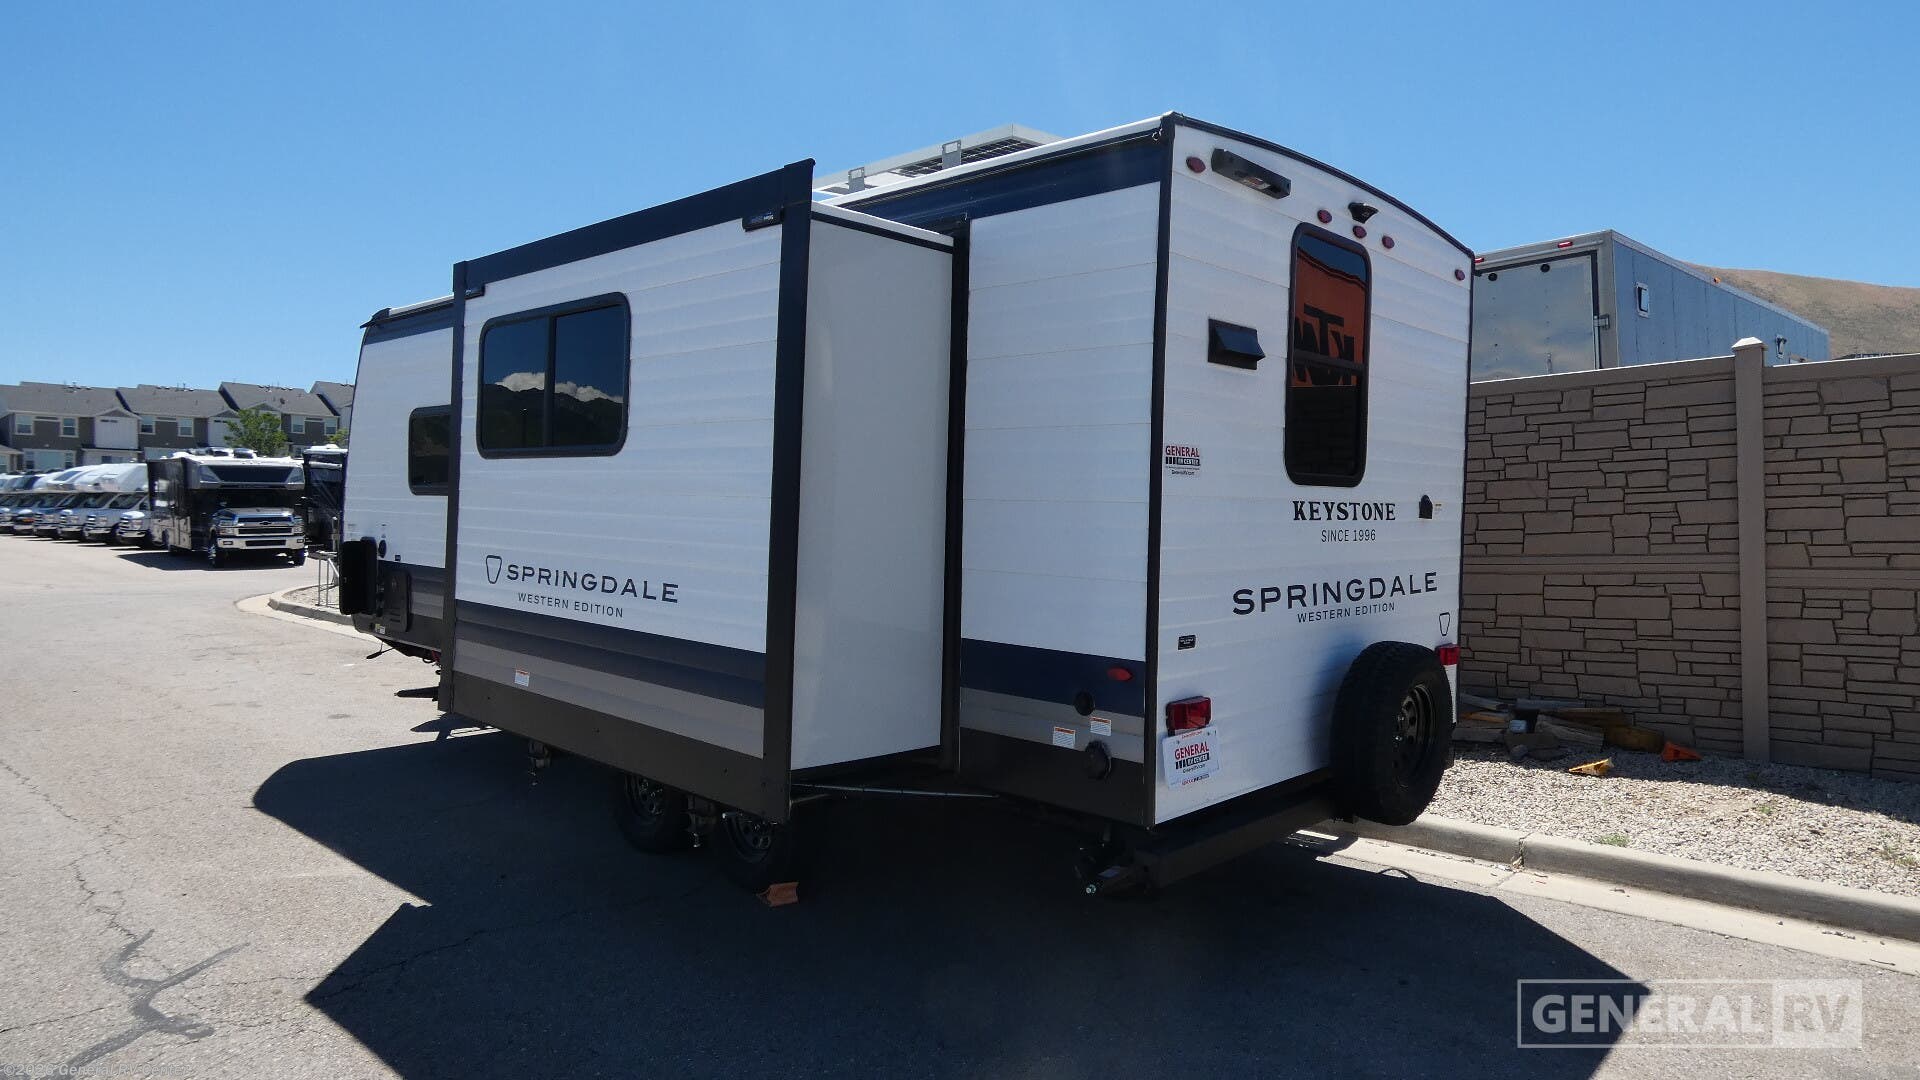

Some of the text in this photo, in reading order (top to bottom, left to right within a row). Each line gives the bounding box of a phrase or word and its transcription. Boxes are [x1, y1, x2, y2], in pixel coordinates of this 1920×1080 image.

[1165, 446, 1200, 457] GENERAL
[1292, 500, 1396, 521] KEYSTONE
[1321, 529, 1376, 543] SINCE 1996
[506, 563, 680, 604] SPRINGDALE
[1232, 571, 1438, 616] SPRINGDALE
[517, 592, 624, 618] WESTERN EDITION
[1297, 602, 1395, 623] WESTERN EDITION
[1175, 743, 1209, 759] GENERAL
